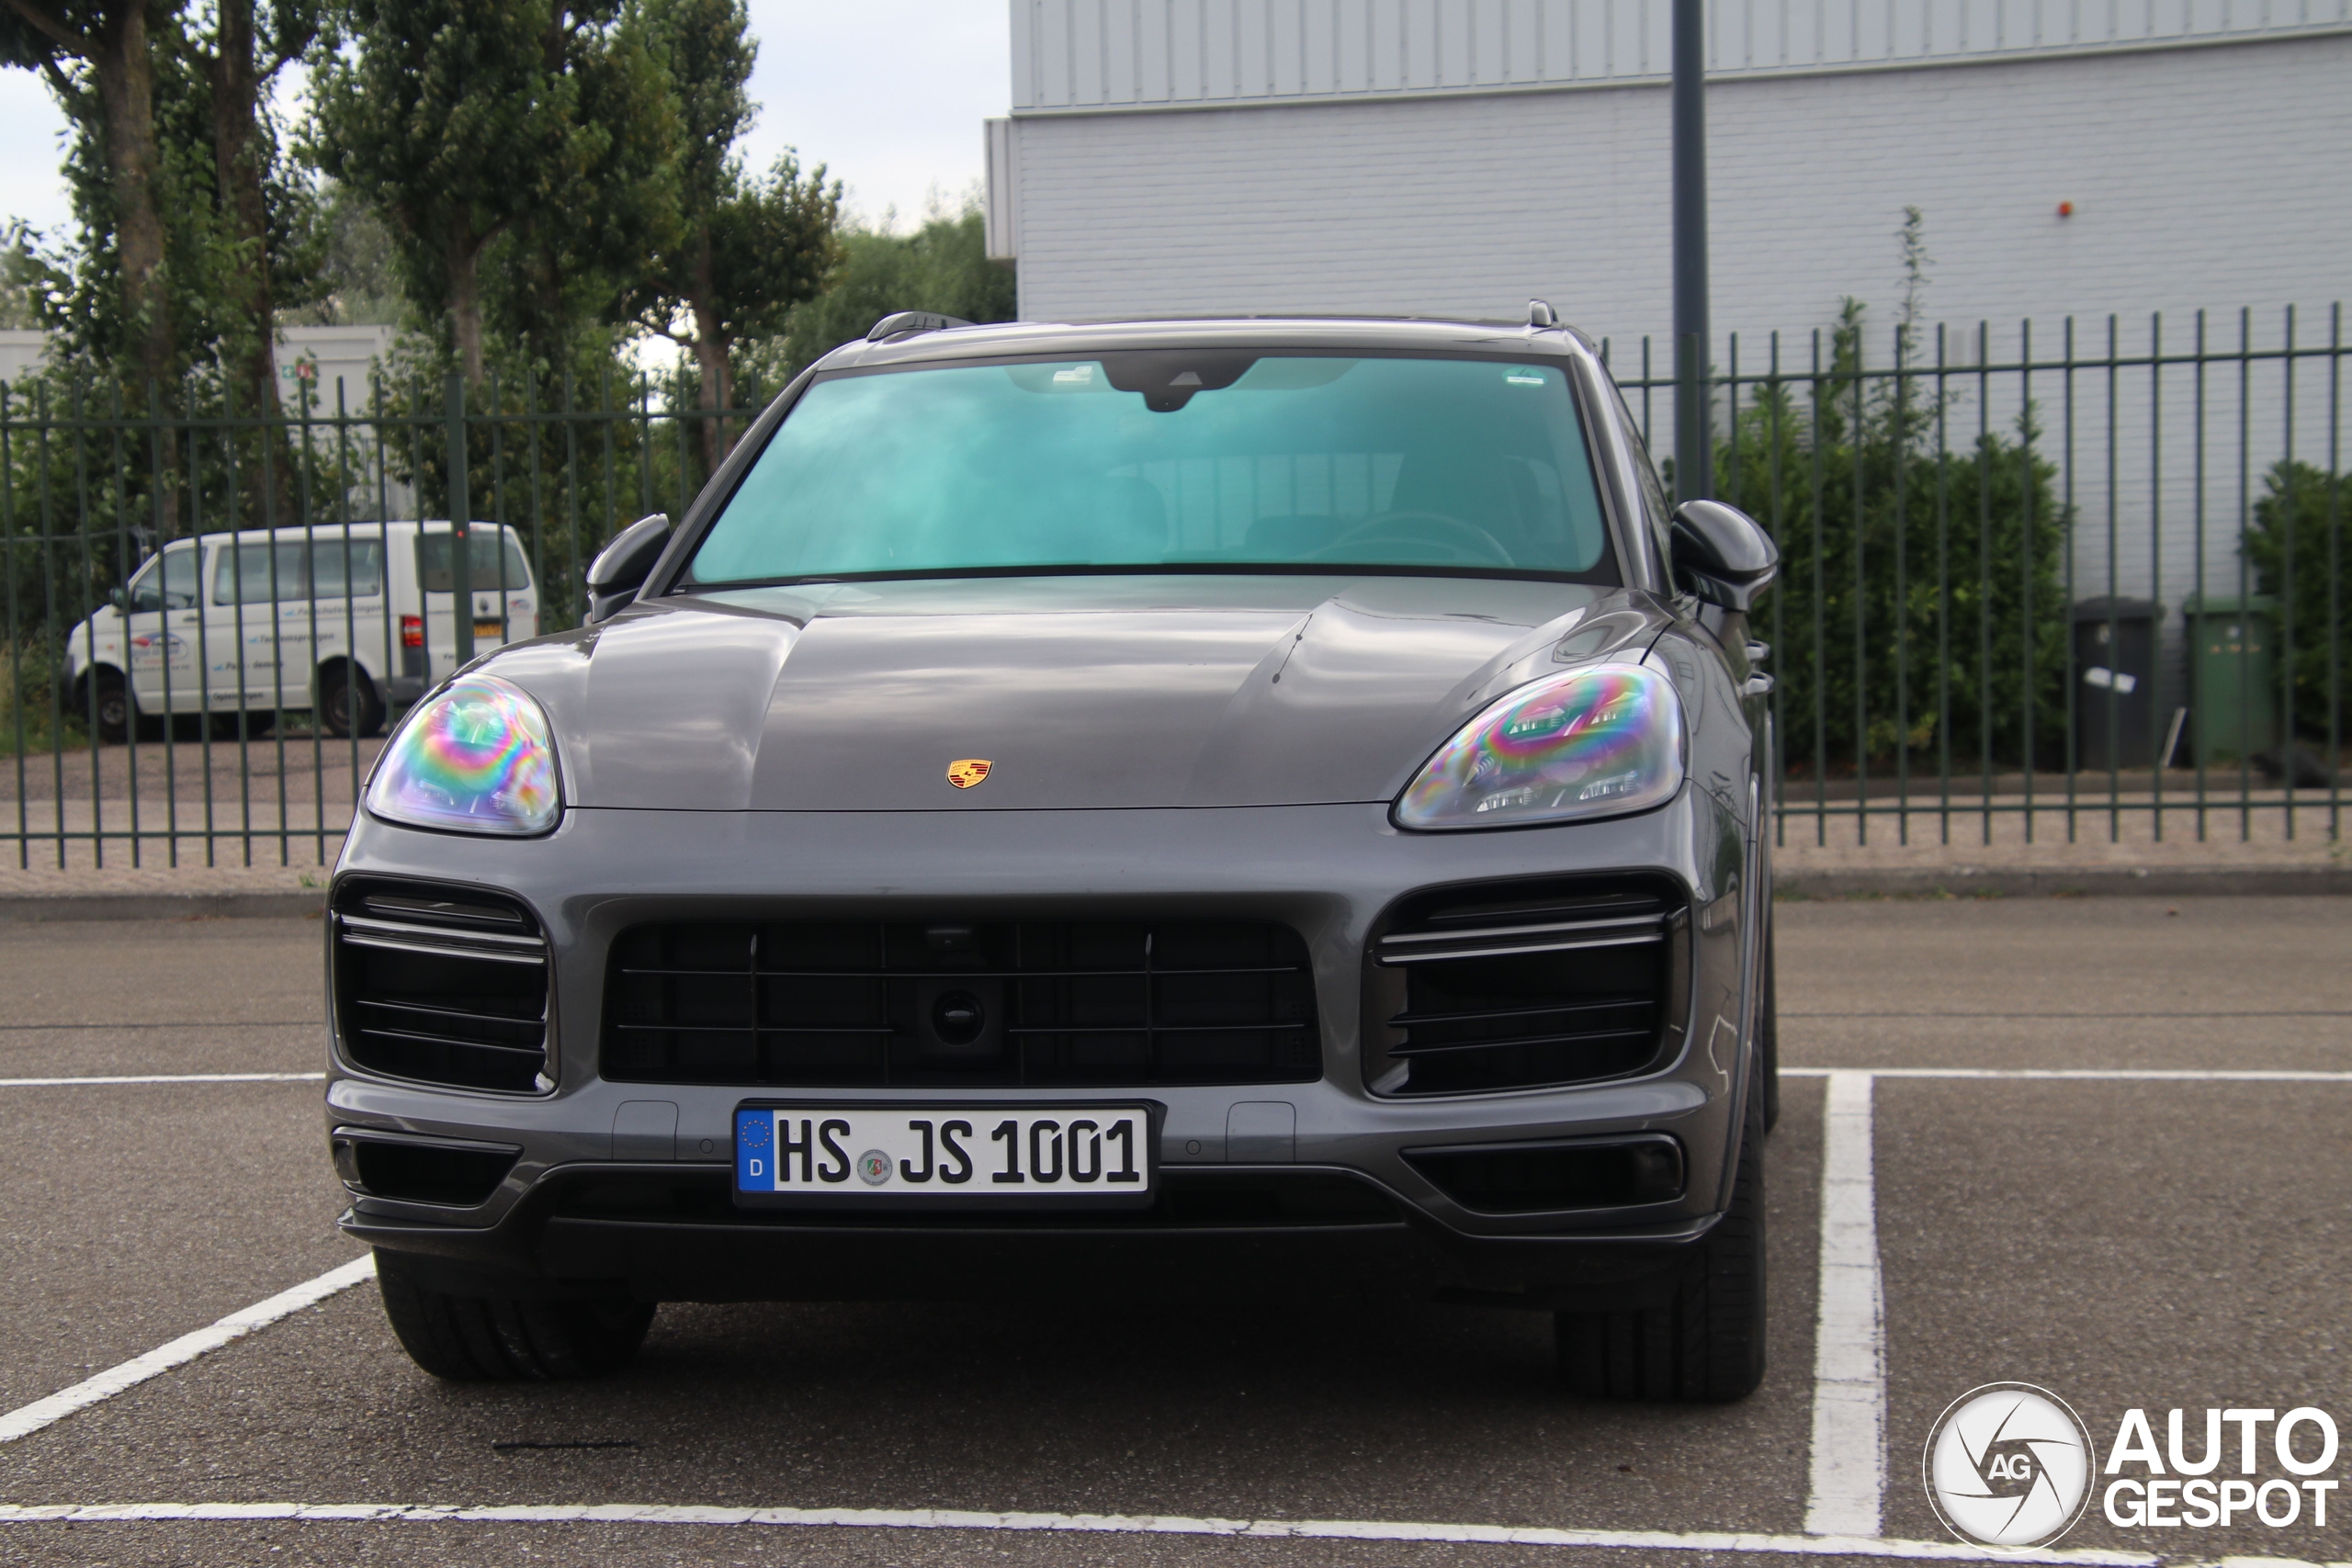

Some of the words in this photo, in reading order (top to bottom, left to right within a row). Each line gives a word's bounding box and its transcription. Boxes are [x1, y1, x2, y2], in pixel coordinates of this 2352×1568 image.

[750, 1159, 763, 1177] D
[778, 1119, 852, 1183] HS
[899, 1120, 973, 1184] JS
[991, 1119, 1140, 1183] 1001
